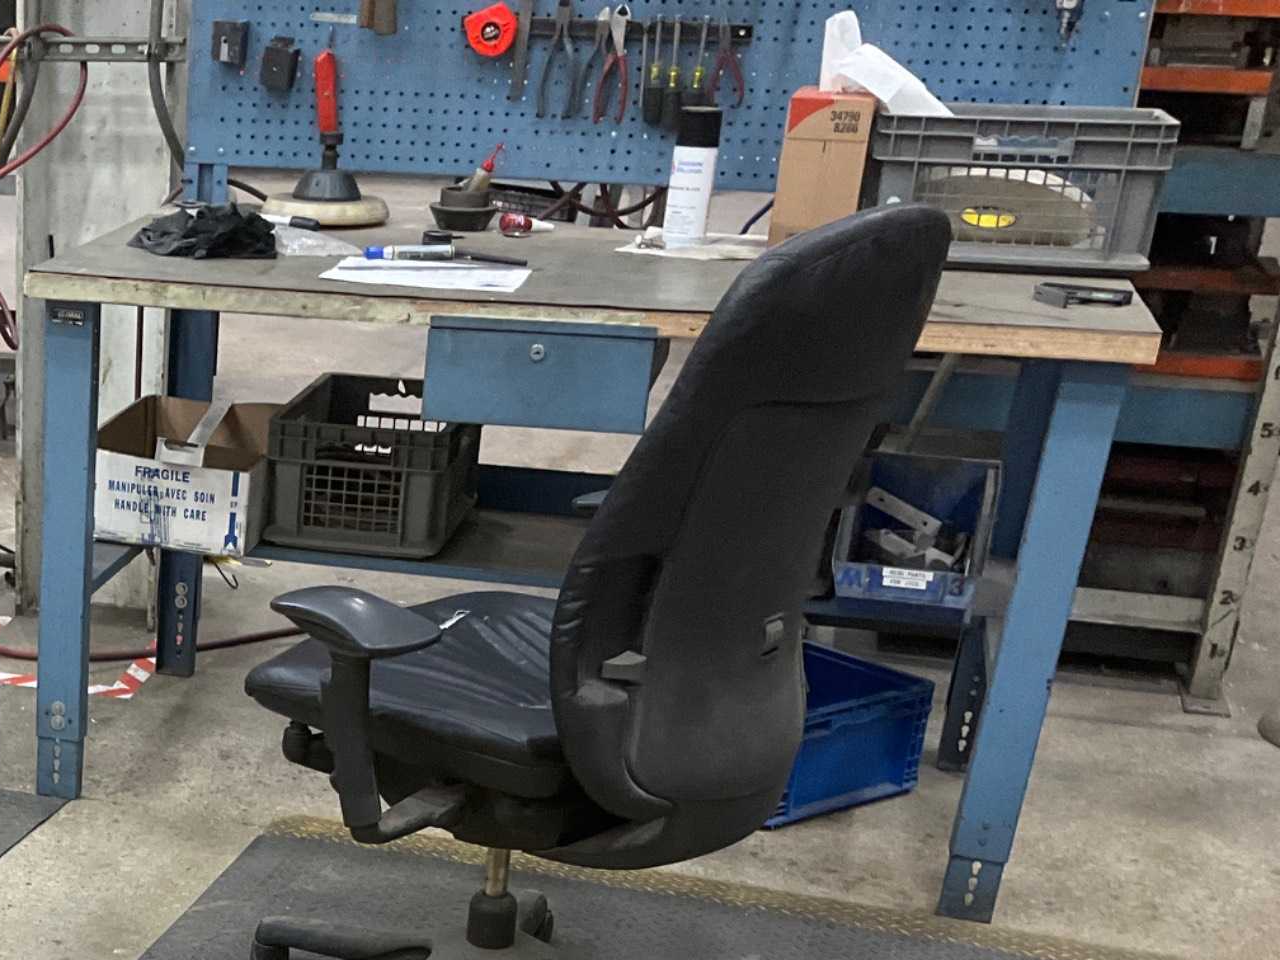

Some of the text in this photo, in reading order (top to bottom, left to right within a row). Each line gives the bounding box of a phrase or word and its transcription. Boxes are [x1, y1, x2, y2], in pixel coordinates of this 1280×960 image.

[135, 465, 191, 483] FRAGILE
[108, 479, 215, 504] MANIPULER AVEC SOIN
[114, 498, 207, 521] HANDLE WITH CARE
